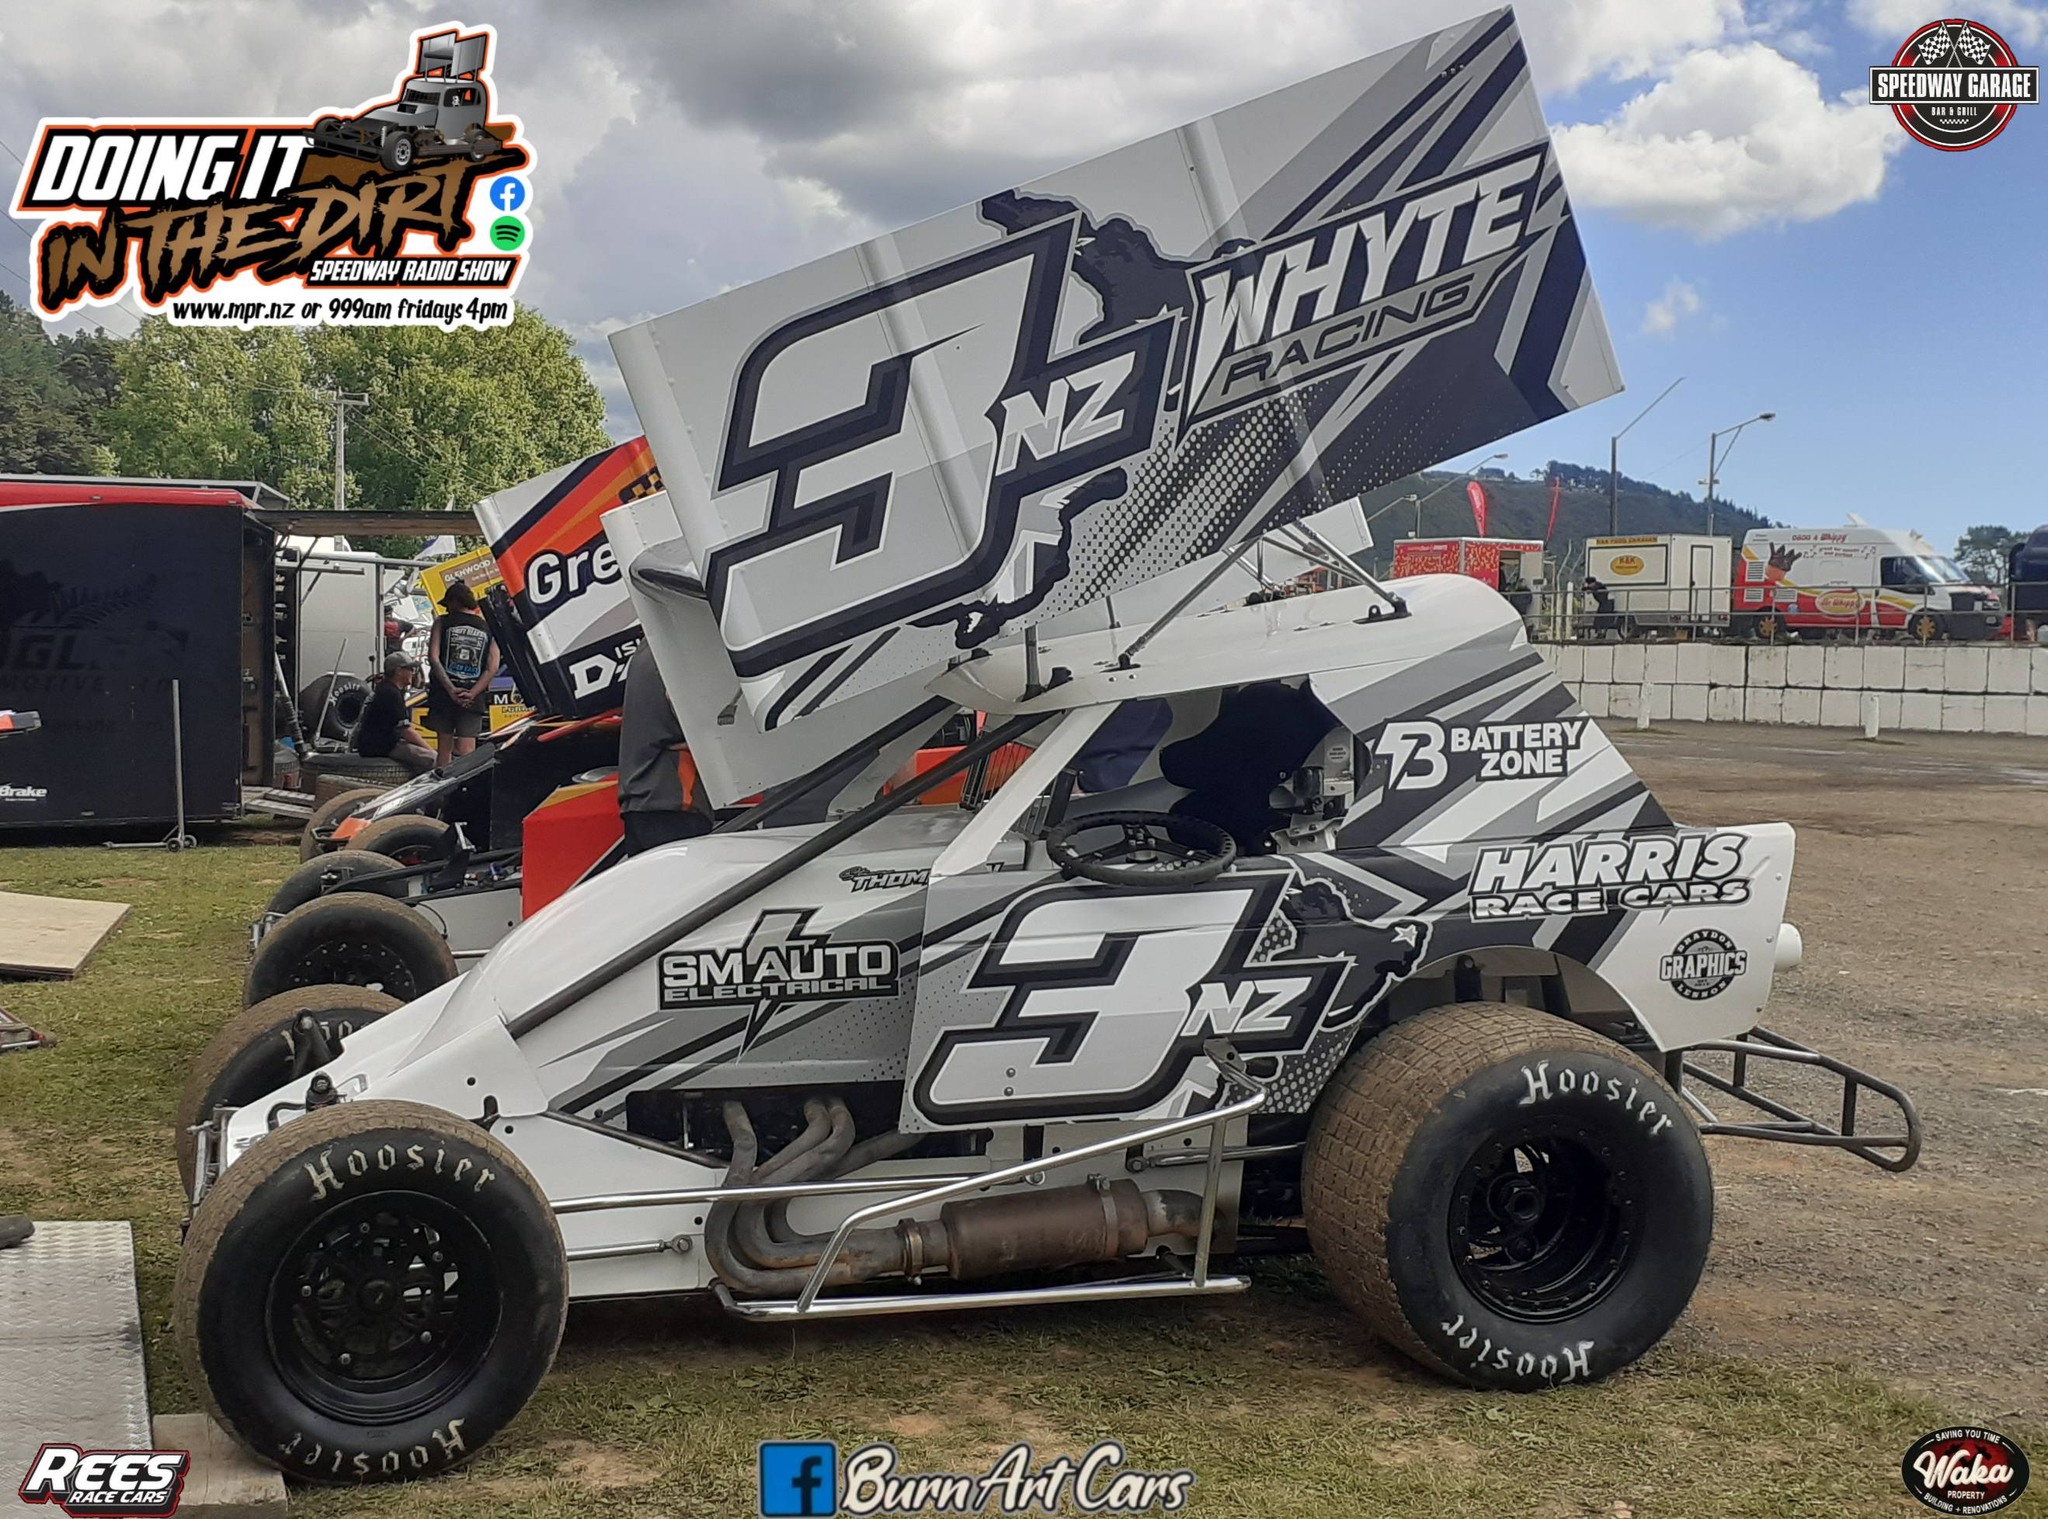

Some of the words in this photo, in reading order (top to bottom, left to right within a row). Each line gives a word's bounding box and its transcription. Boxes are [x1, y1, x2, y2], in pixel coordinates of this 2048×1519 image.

[1187, 152, 1543, 418] WHYTE
[1221, 271, 1477, 396] RACING
[720, 253, 1036, 652] 3
[993, 350, 1137, 478] NZ
[1450, 720, 1584, 753] BATTERY
[1480, 749, 1564, 778] ZONE
[1471, 833, 1748, 894] HARRIS
[1475, 890, 1602, 917] RACE
[1621, 880, 1750, 907] CARS
[663, 953, 743, 988] SM
[752, 945, 892, 983] AUTO
[664, 977, 892, 1003] ELECTRICAL
[1661, 950, 1746, 981] GRAPHICS
[927, 887, 1257, 1106] 3
[1183, 978, 1312, 1036] NZ
[1518, 1059, 1674, 1137] Hoosier
[303, 1140, 496, 1200] Hoosier
[1441, 1314, 1596, 1384] Hoosier
[279, 1417, 467, 1475] Hoosier
